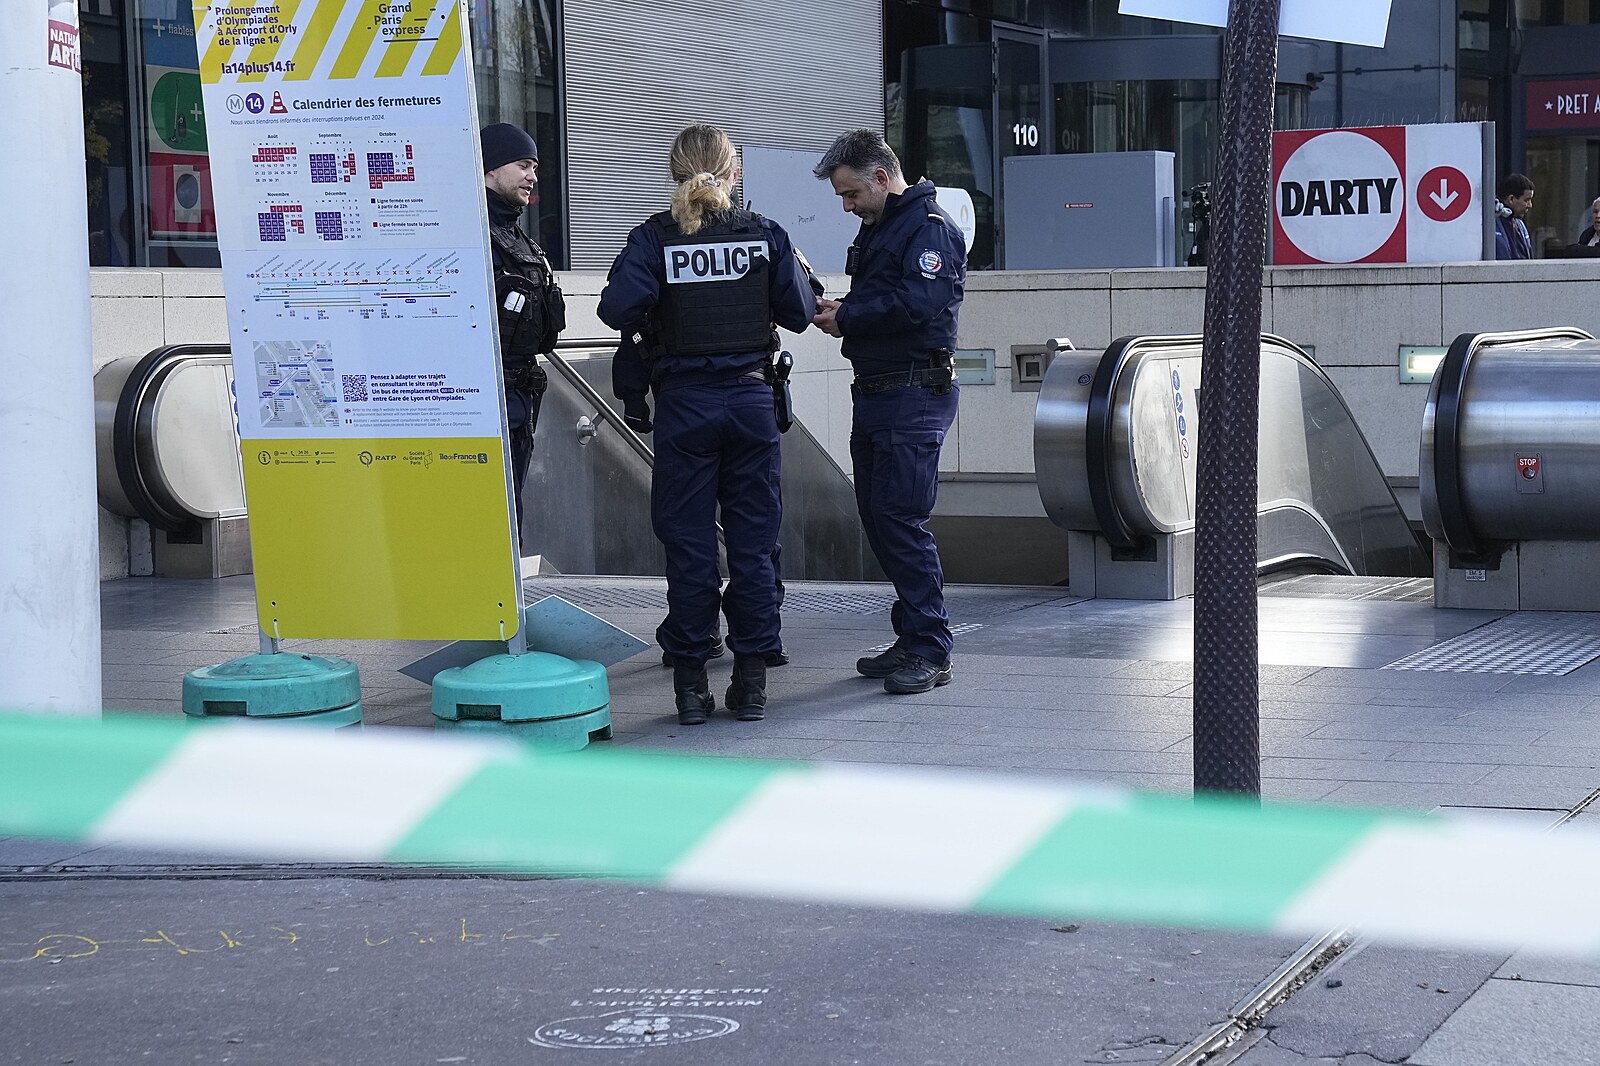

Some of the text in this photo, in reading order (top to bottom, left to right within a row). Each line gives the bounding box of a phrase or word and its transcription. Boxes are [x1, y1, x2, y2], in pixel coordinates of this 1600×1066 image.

[215, 5, 280, 15] Prolongement
[379, 2, 412, 13] Grand
[216, 15, 278, 26] d'Olympiades
[374, 15, 402, 25] Paris
[51, 28, 76, 44] NATH
[168, 24, 194, 36] fiables
[226, 26, 267, 36] Aéroport
[269, 24, 297, 35] d'Orly
[382, 26, 425, 37] express
[218, 38, 230, 46] de
[232, 37, 241, 45] la
[243, 36, 266, 46] ligne
[221, 61, 296, 75] la14plus14.fr
[248, 98, 262, 109] 14
[293, 96, 441, 110] Calendrier des fermetures
[1558, 94, 1589, 115] PRET
[1013, 124, 1038, 147] 110
[1280, 178, 1398, 217] DARTY
